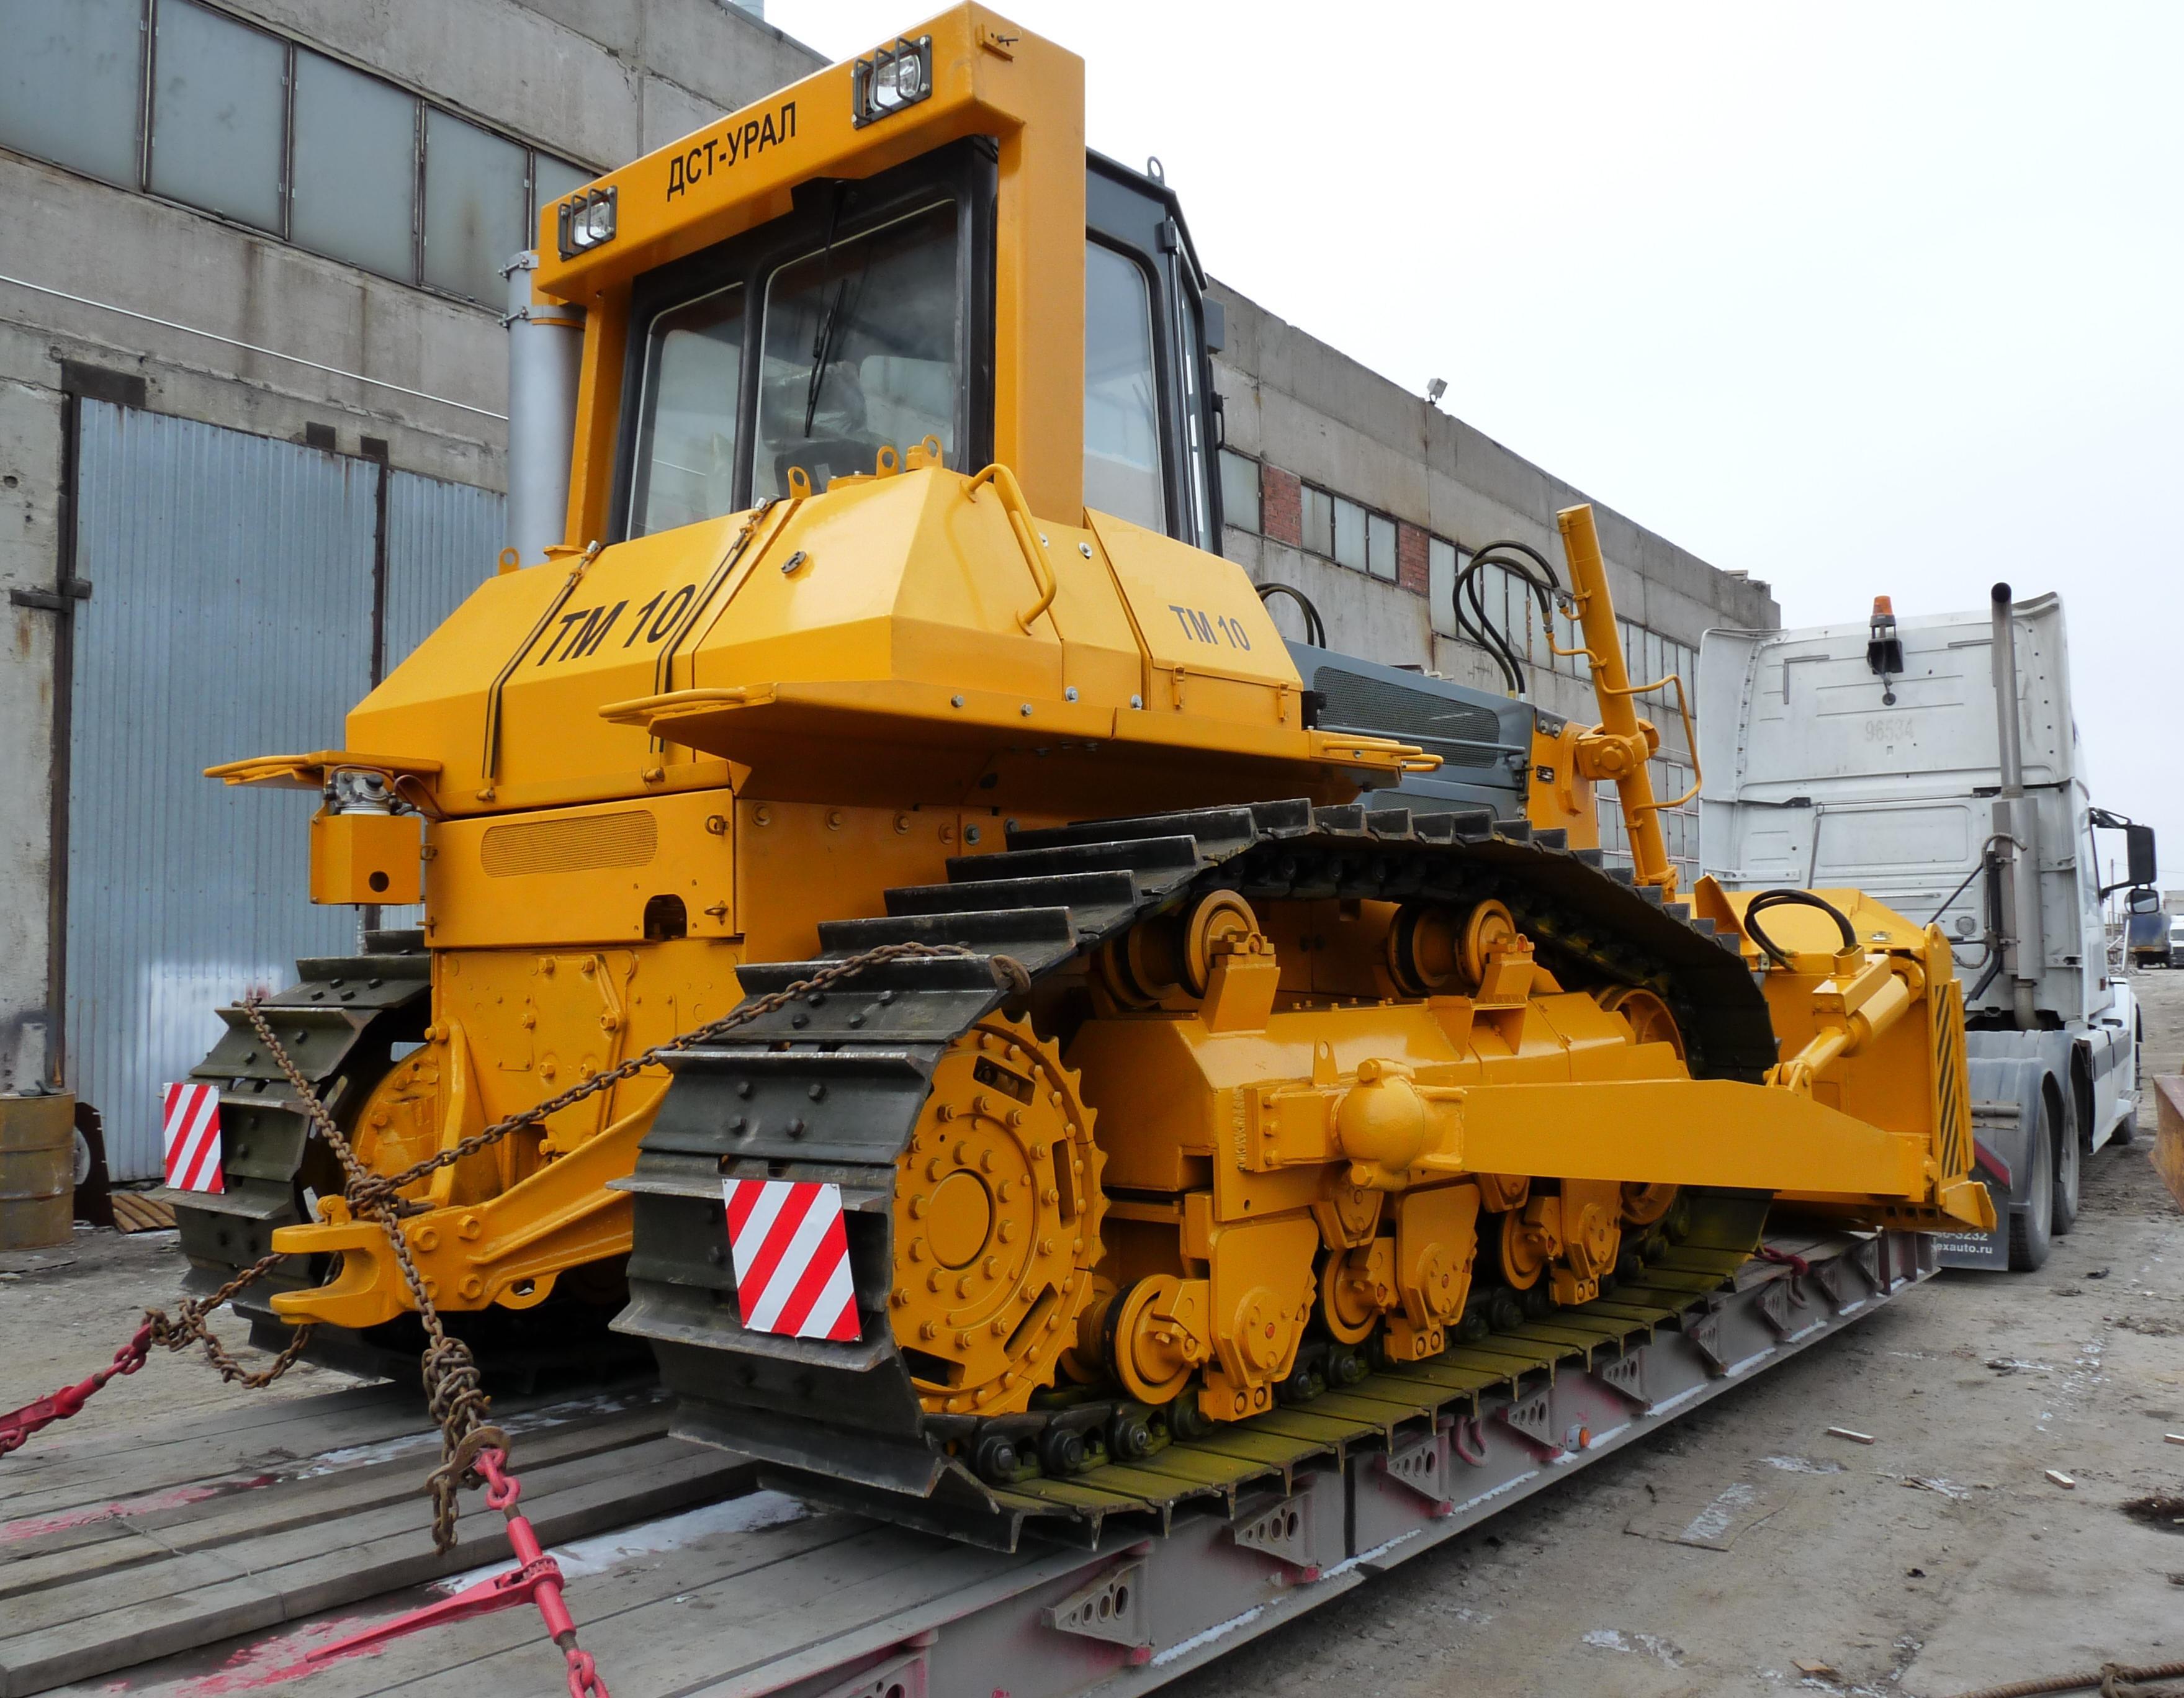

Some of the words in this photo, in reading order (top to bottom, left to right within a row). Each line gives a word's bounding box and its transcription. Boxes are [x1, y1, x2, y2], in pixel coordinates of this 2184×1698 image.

[667, 101, 796, 203] ДСТ-УРАЛ
[536, 600, 629, 667] ТМ
[622, 583, 696, 649] 10
[1167, 604, 1219, 645] ТМ
[1217, 614, 1251, 652] 10
